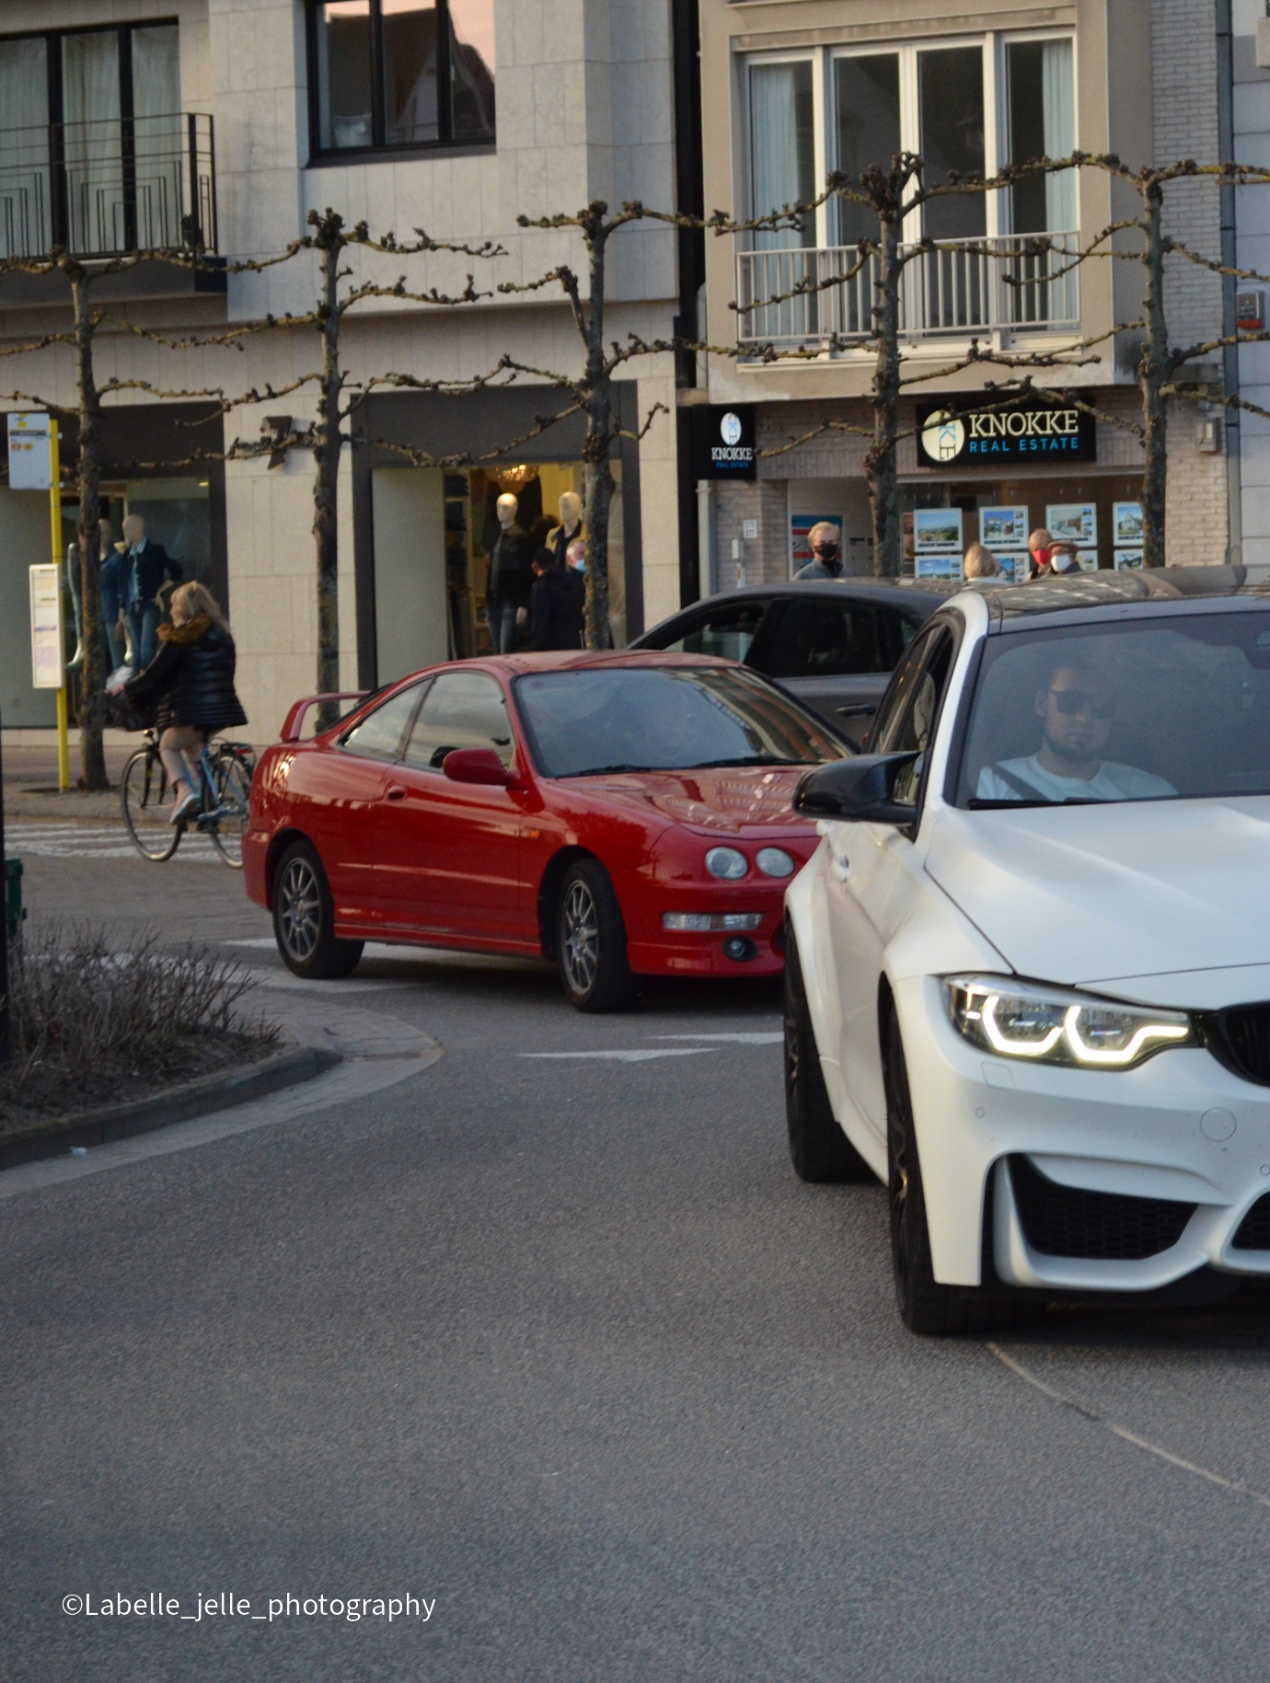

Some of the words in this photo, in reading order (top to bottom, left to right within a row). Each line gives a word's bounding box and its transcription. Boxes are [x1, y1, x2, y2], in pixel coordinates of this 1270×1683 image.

[968, 409, 1079, 438] KNOKKE
[969, 439, 1010, 453] REAL
[1019, 436, 1079, 451] ESTATE
[711, 446, 753, 461] KNOKKE
